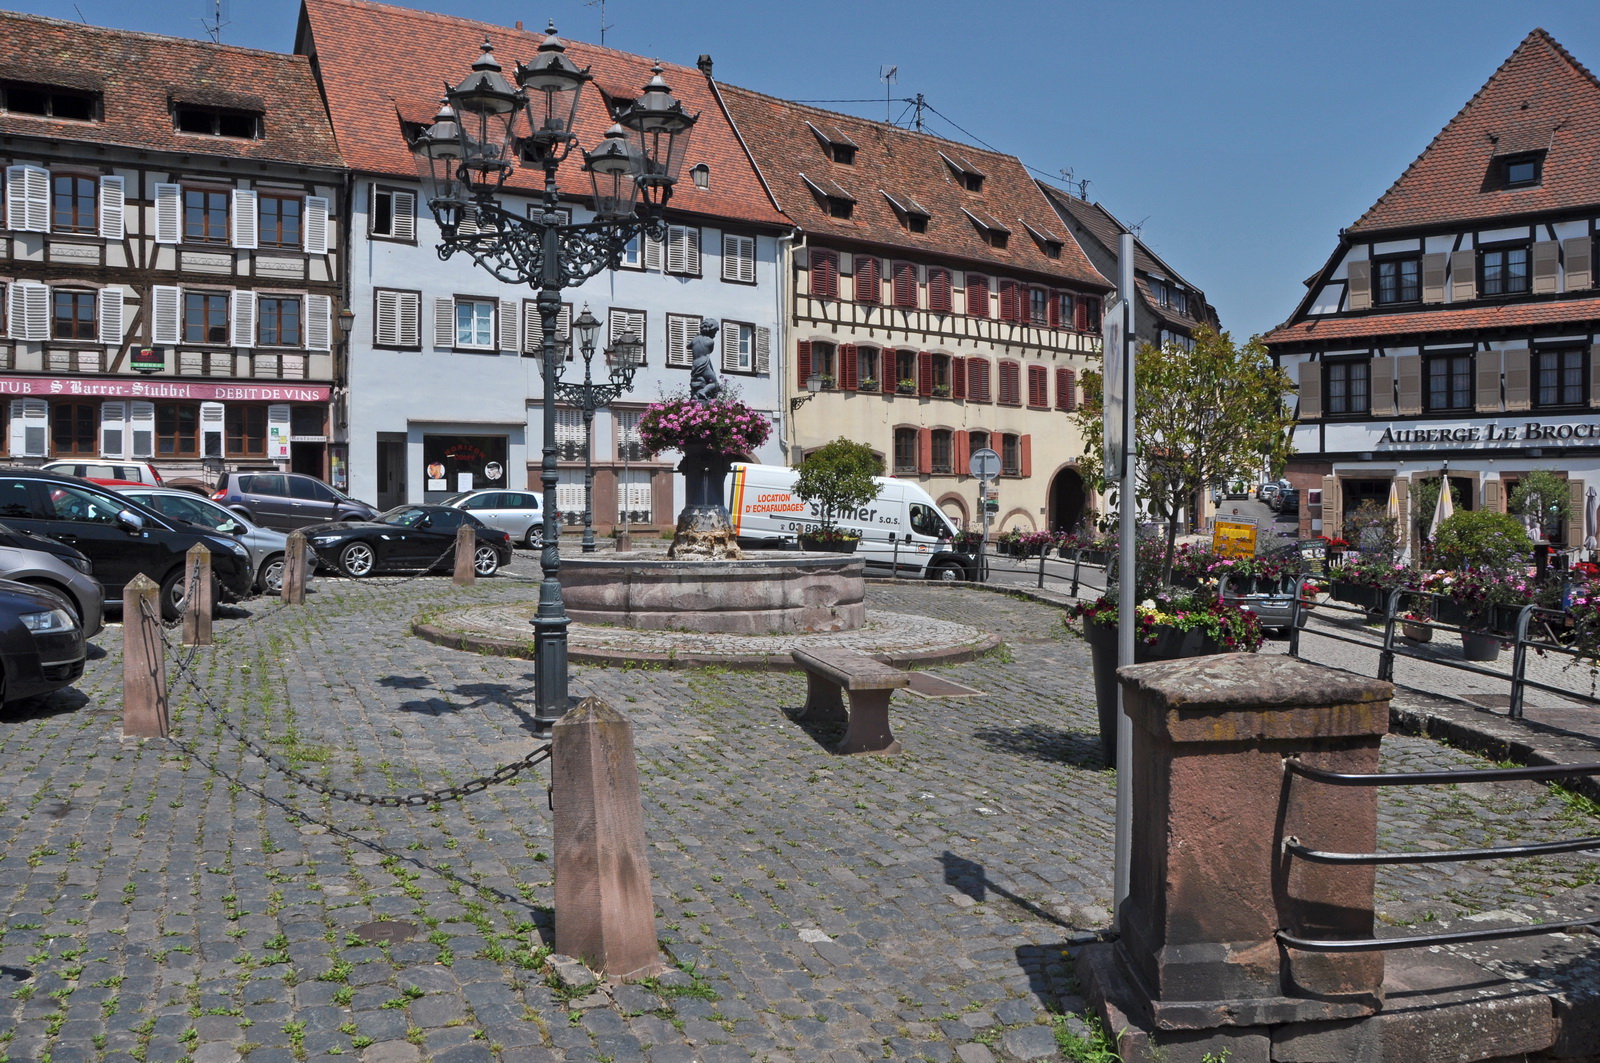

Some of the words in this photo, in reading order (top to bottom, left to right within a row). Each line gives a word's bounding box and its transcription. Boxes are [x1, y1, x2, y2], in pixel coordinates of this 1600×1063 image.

[215, 388, 258, 399] DEBIT
[261, 389, 281, 399] DE
[283, 389, 320, 401] VINS
[1378, 426, 1481, 443] AUBERGE
[1486, 423, 1517, 441] LE
[757, 493, 791, 502] LOCATION
[745, 503, 804, 513] D'ECHAFAUDAGES
[879, 515, 901, 525] s.a.s.
